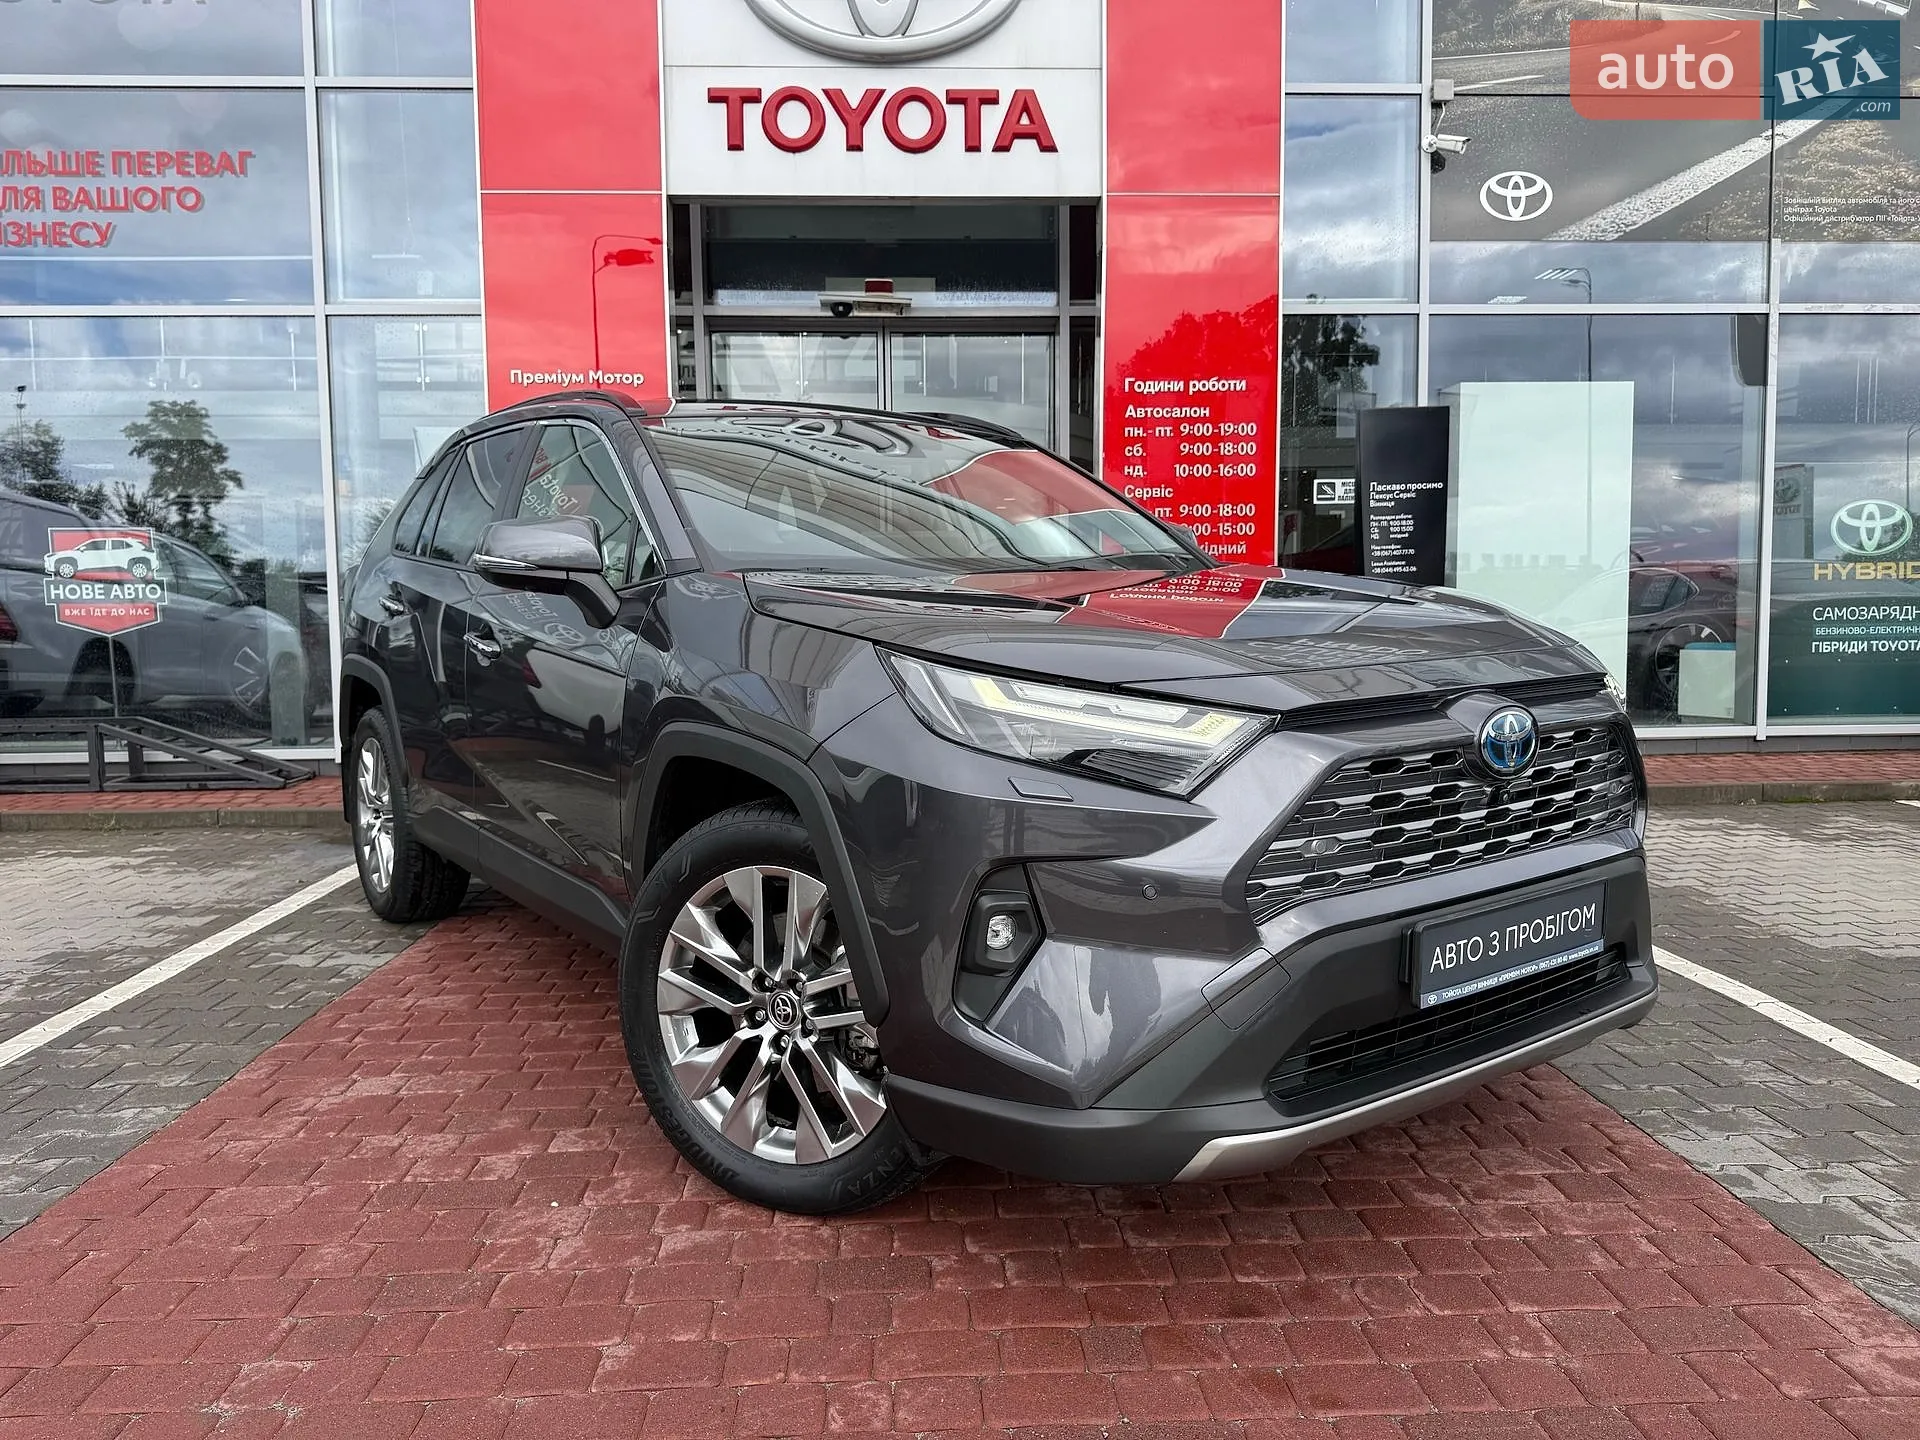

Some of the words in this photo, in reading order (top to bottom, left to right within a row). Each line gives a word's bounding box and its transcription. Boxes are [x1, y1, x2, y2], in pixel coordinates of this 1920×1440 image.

[707, 85, 1059, 154] TOYOTA
[111, 150, 255, 176] ПЕРЕВАГ
[52, 186, 203, 212] ВАШОГО
[510, 369, 585, 388] Преміум
[588, 370, 645, 387] Мотор
[1124, 377, 1184, 394] Години
[1188, 376, 1247, 395] роботи
[1125, 404, 1210, 418] Автосалон
[1124, 443, 1147, 457] сб.
[1124, 465, 1148, 478] нд.
[1124, 484, 1174, 500] Сервіс
[1369, 481, 1406, 491] Ласкаво
[1407, 482, 1443, 491] просимо
[50, 584, 105, 600] НОВЕ
[110, 583, 161, 599] АВТО
[64, 608, 86, 616] ВЖЕ
[111, 608, 125, 616] ДО
[129, 608, 150, 616] НАС
[1811, 641, 1868, 654] ГІБРИДИ
[1430, 935, 1484, 973] АВТО
[1505, 902, 1596, 951] ПРОБІГОМ
